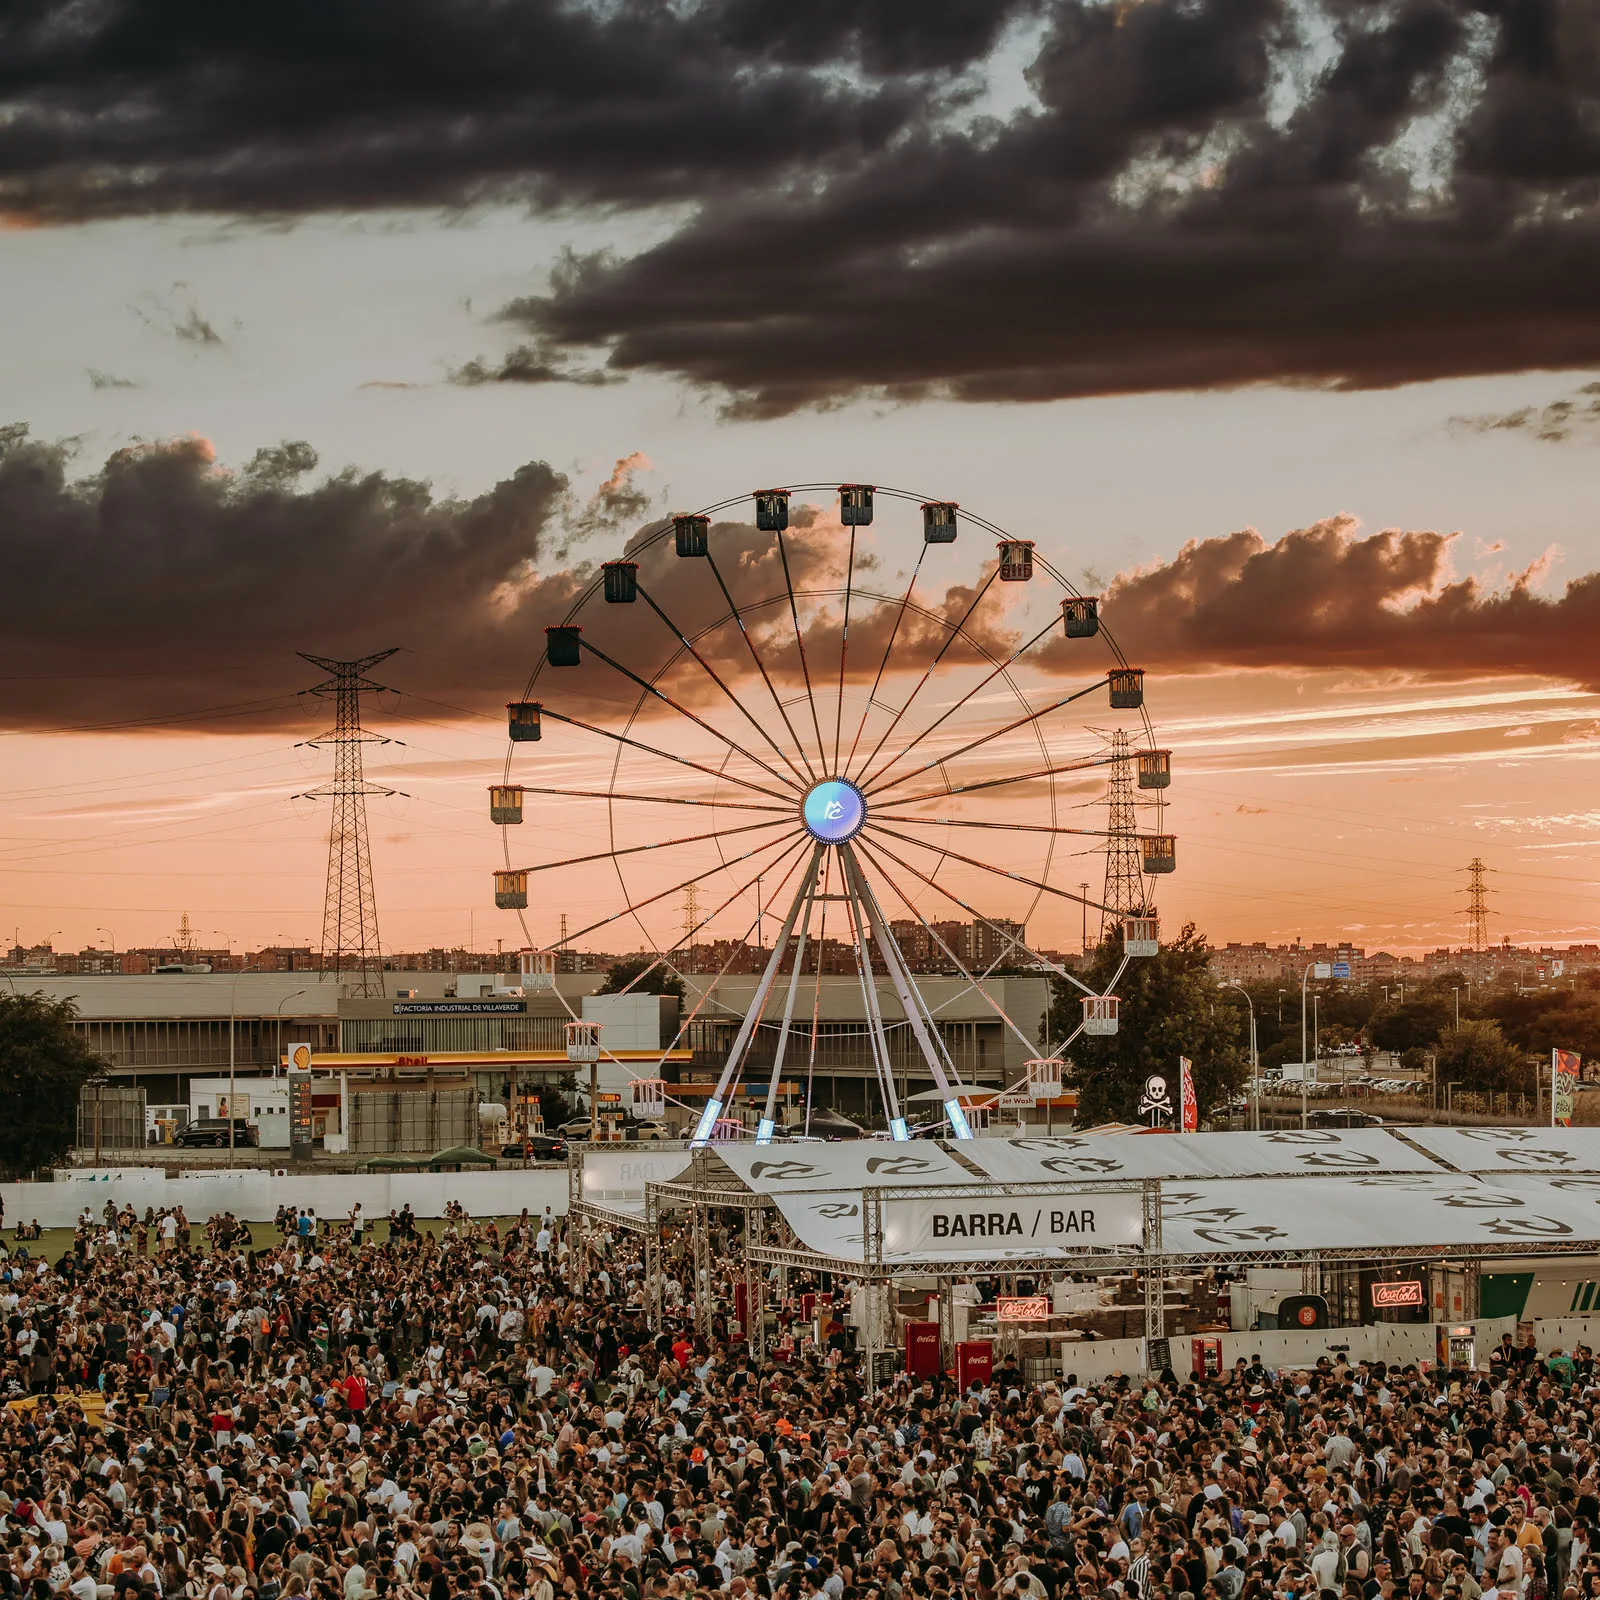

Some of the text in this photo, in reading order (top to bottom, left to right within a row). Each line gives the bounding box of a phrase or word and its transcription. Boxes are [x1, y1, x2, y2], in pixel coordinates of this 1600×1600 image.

[401, 1004, 432, 1012] FACTORÍA
[434, 1004, 471, 1012] INDUSTRIAL
[397, 1056, 427, 1066] Shell
[932, 1209, 1095, 1237] BARRA / BAR
